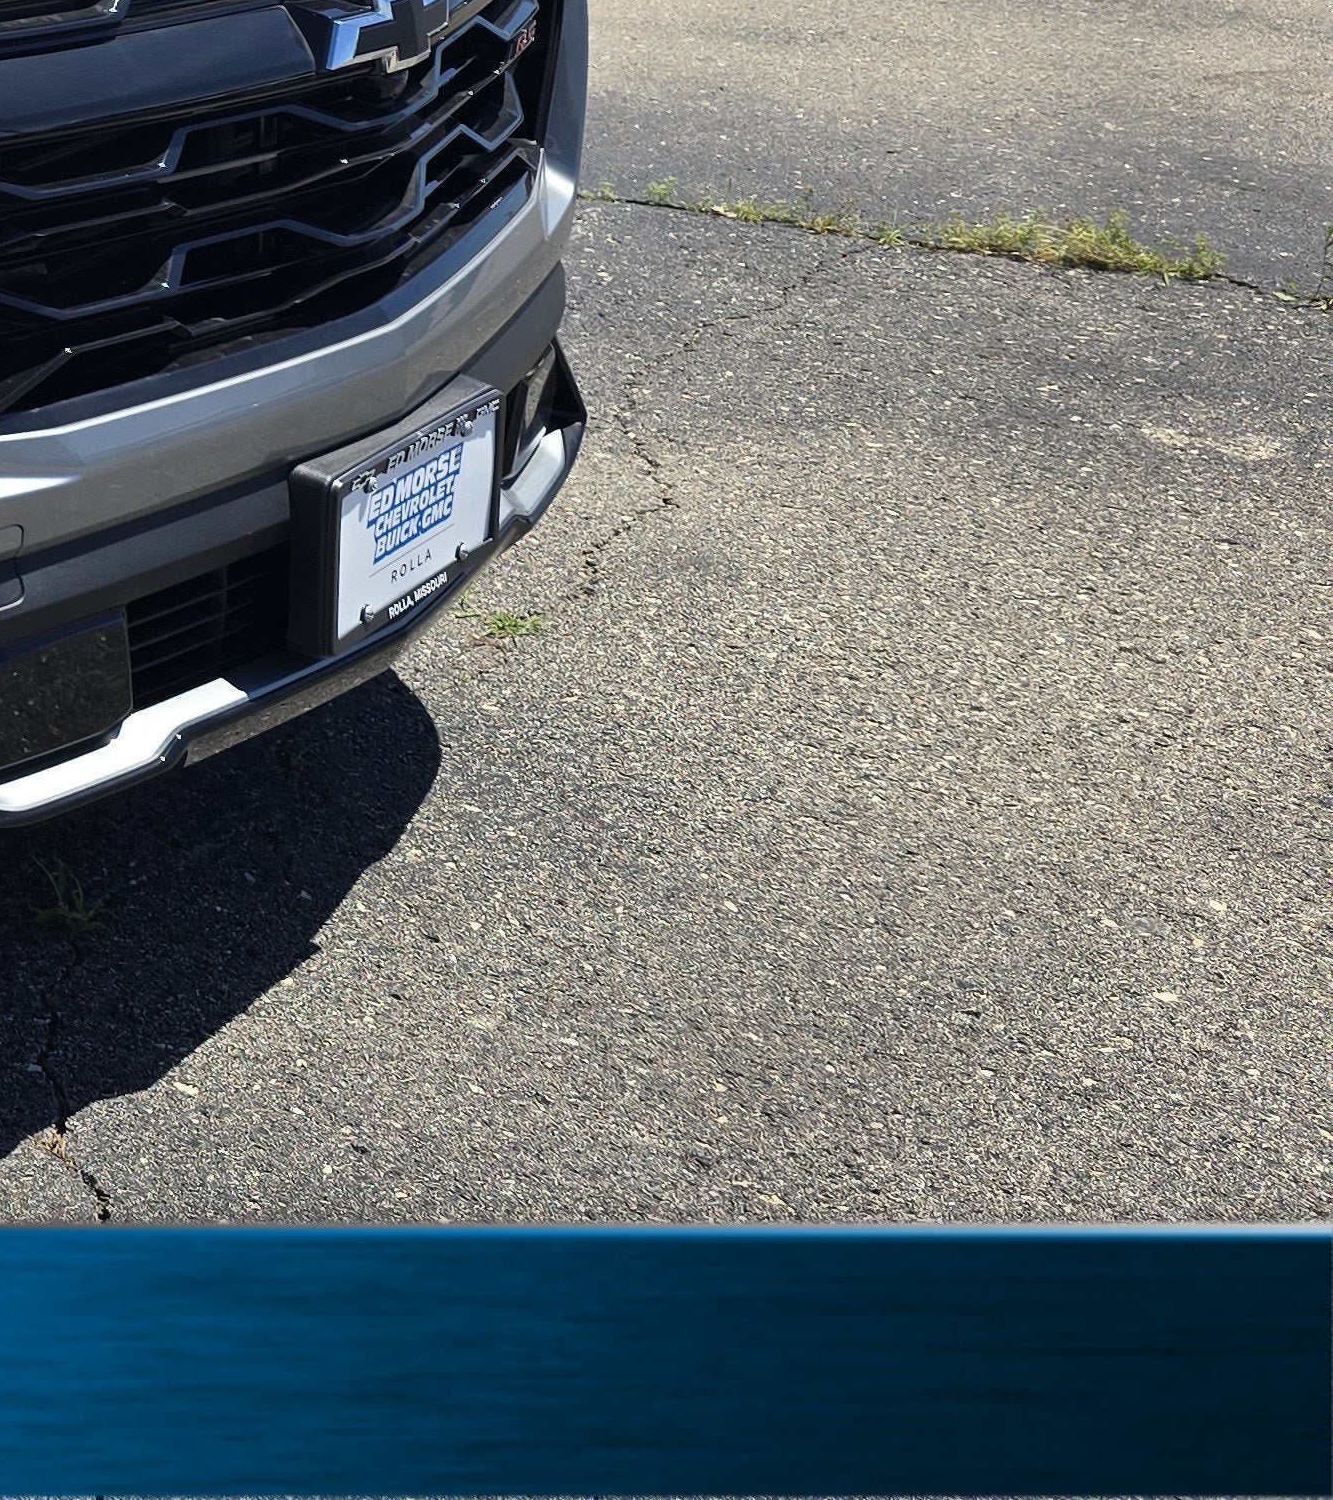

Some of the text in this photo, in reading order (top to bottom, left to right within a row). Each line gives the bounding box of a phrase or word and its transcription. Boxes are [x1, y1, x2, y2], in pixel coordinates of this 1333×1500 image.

[387, 399, 500, 474] ED MORSE GMC
[369, 444, 464, 522] ED MORSE
[374, 475, 455, 537] CHEVROLET
[391, 548, 432, 584] ROLLA
[414, 571, 448, 602] MISSOURI
